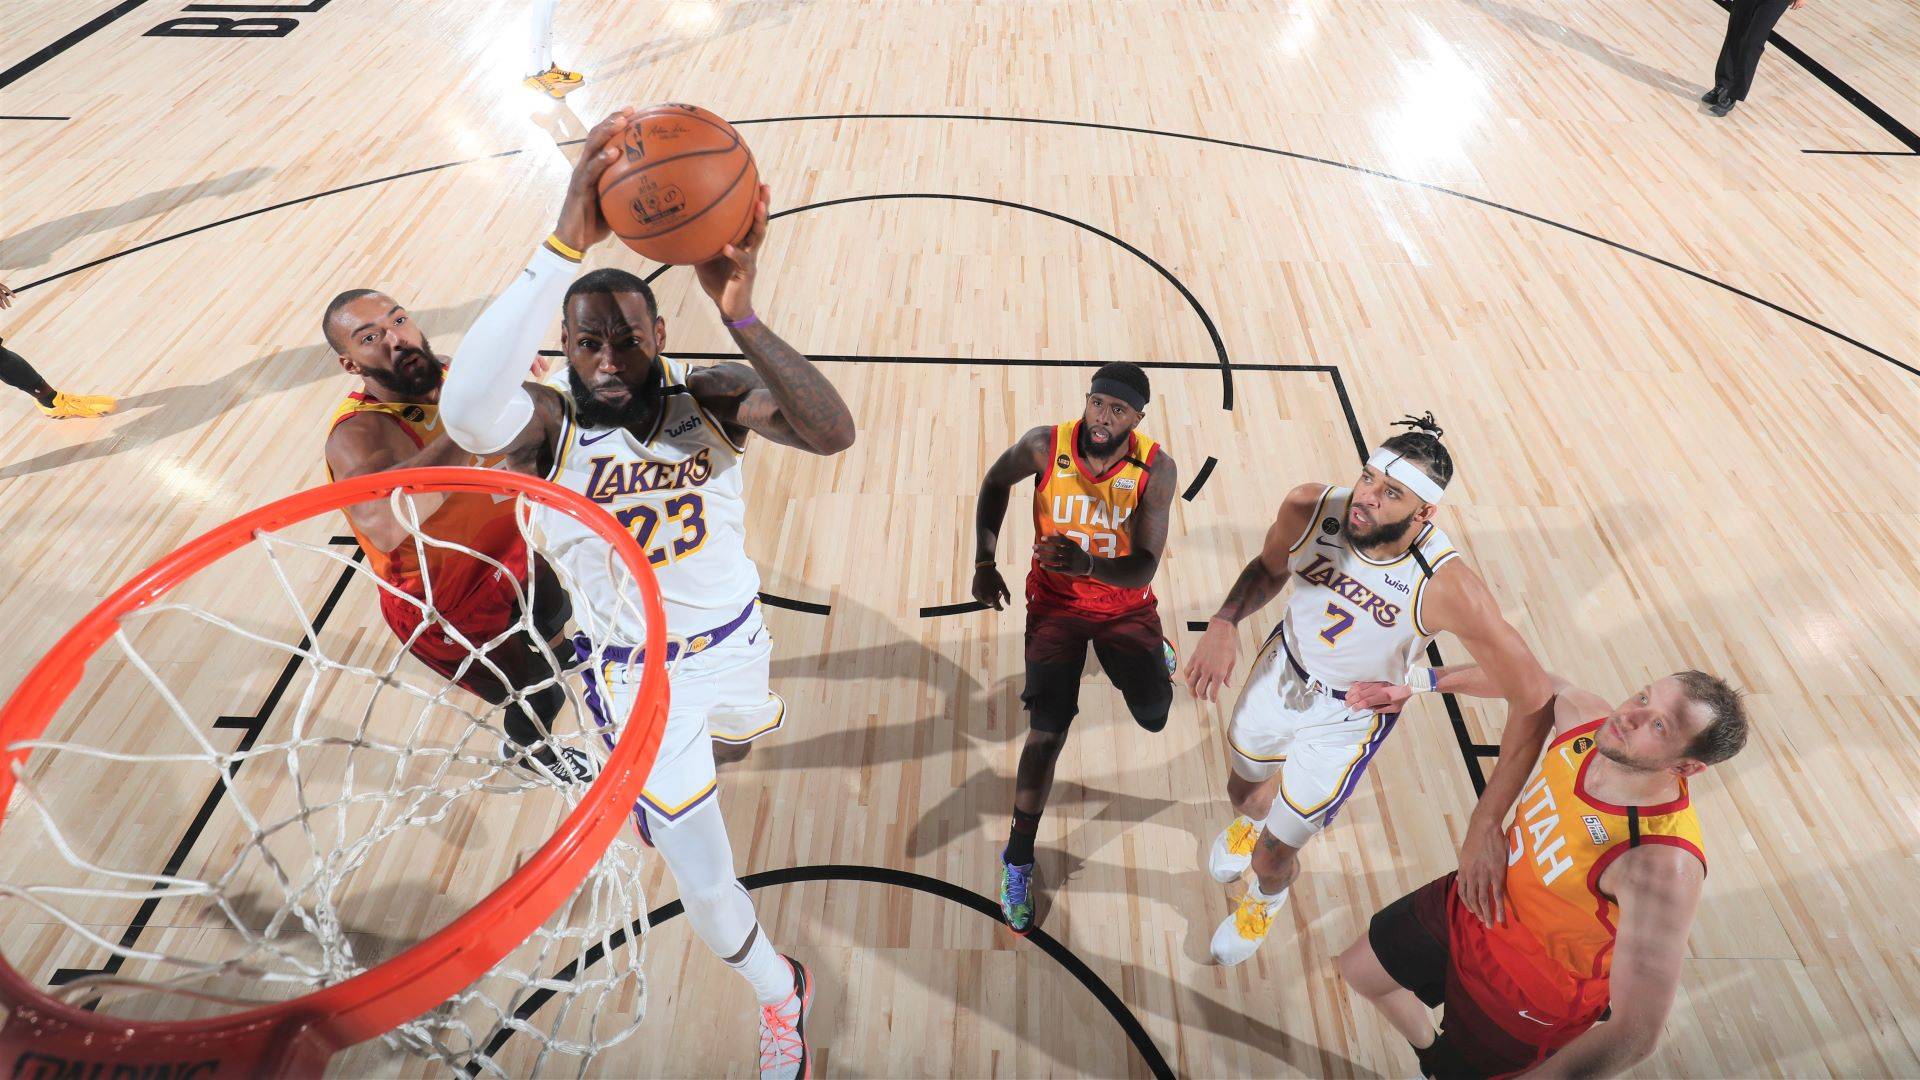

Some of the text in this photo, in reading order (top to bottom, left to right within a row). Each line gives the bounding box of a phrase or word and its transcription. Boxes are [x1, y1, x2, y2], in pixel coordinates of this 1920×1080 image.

[665, 415, 702, 438] wish
[585, 448, 713, 504] LAKERS
[614, 491, 710, 570] 23
[1053, 495, 1133, 530] UTAH
[1296, 553, 1402, 628] LAKERS
[1384, 573, 1411, 595] wish
[1319, 600, 1355, 648] 7
[1522, 777, 1574, 887] UTAH
